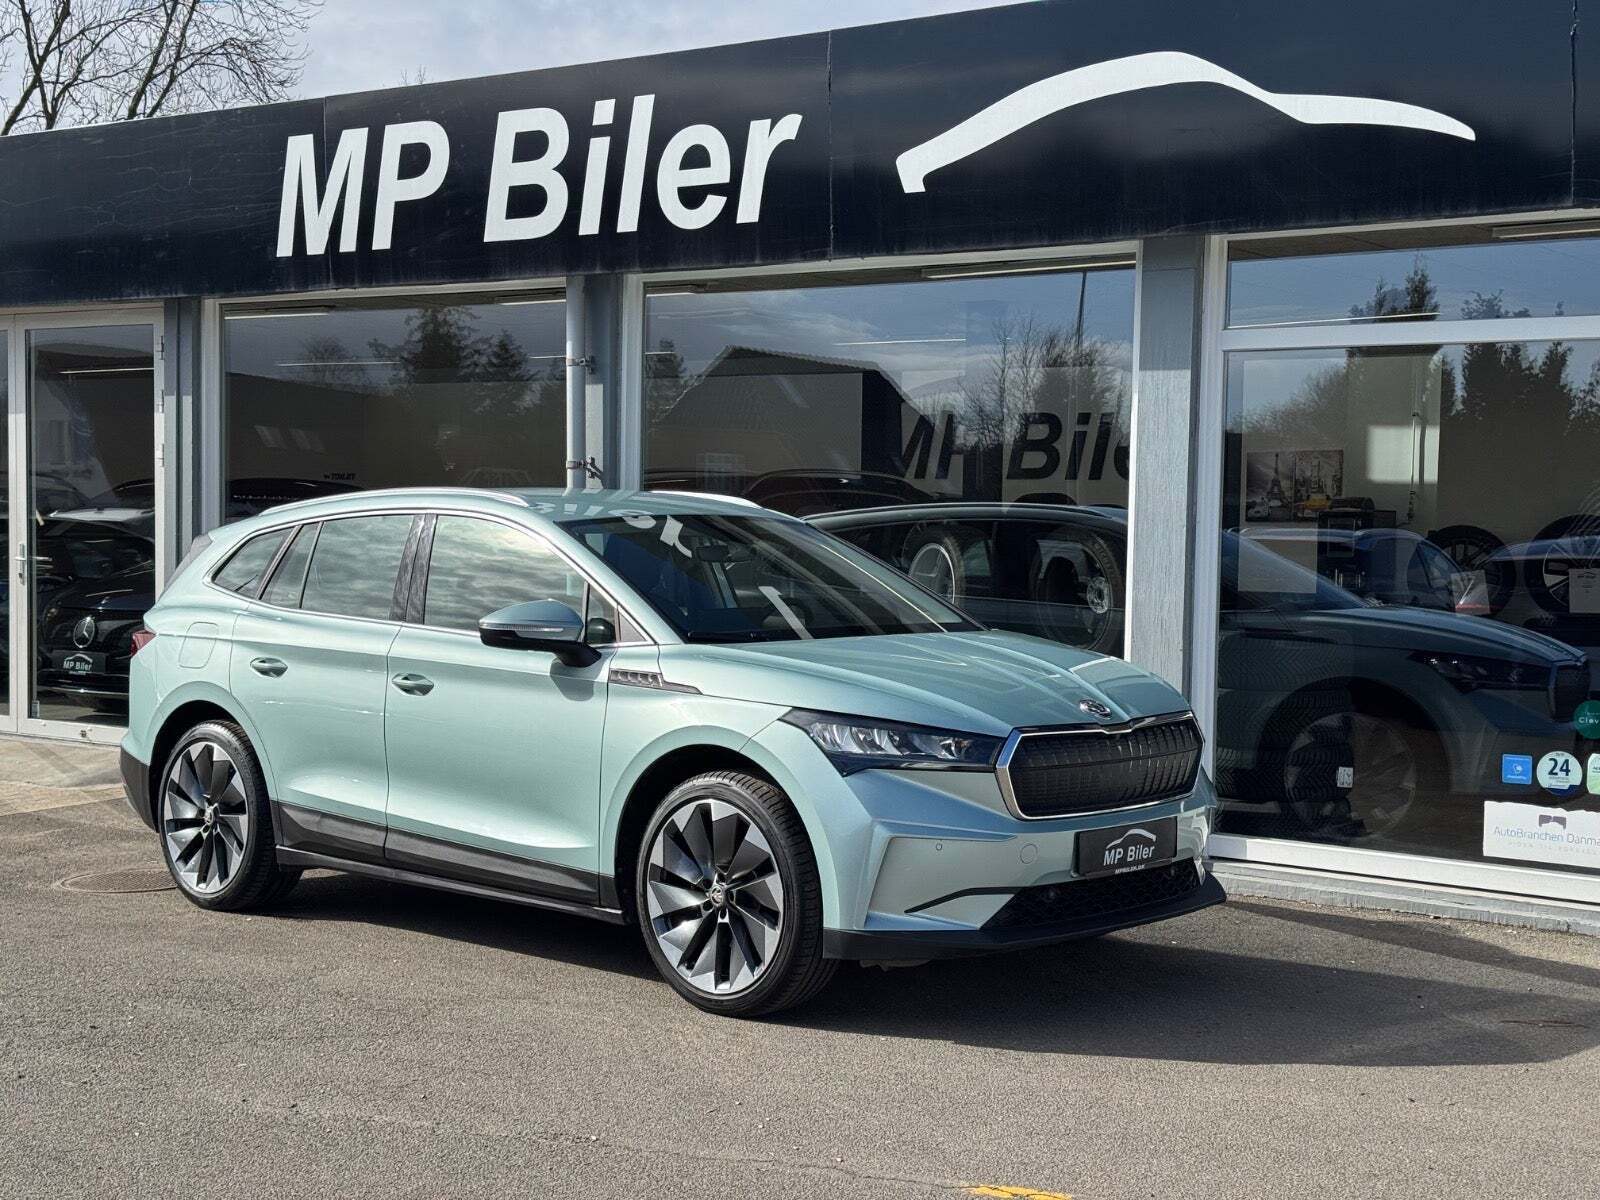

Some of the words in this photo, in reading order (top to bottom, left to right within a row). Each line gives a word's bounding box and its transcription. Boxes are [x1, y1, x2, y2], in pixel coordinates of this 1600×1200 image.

[276, 120, 451, 258] MP
[483, 93, 803, 243] Biler
[63, 660, 74, 669] MP
[75, 661, 92, 671] Biler
[1548, 757, 1571, 777] 24
[1494, 826, 1564, 842] AutoBranchen
[1103, 848, 1124, 866] MP
[1126, 844, 1155, 862] Biler
